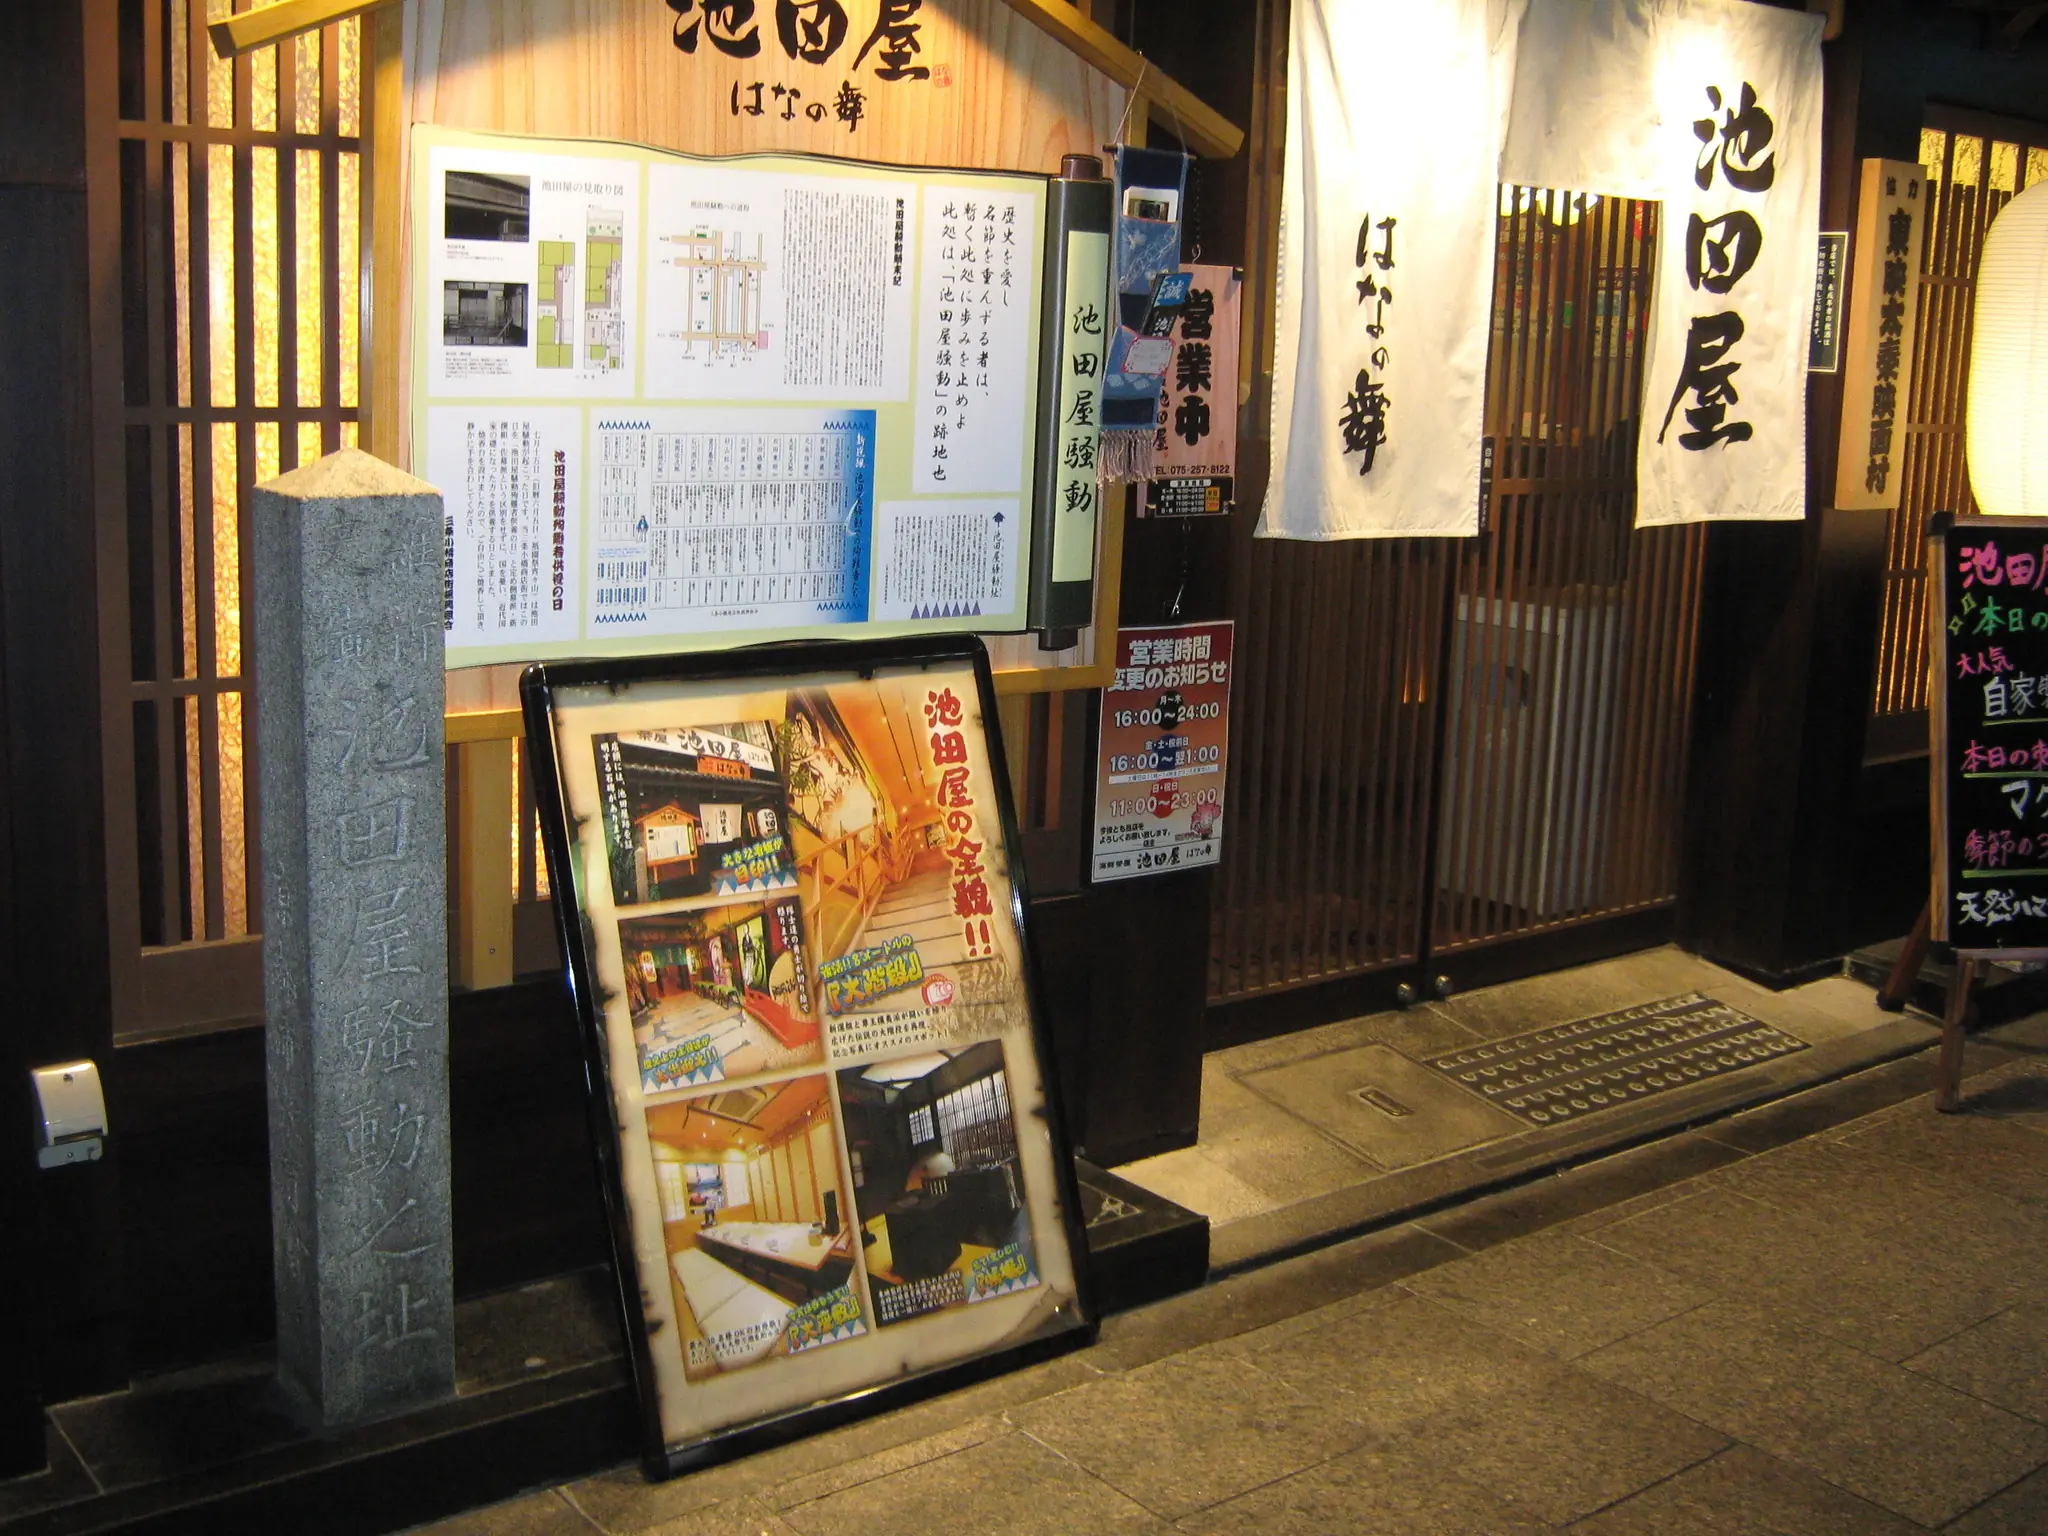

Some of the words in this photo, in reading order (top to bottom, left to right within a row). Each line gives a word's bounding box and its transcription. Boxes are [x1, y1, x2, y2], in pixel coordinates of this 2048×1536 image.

[666, 0, 930, 82] 池田屋
[731, 80, 867, 132] はなの舞
[541, 179, 624, 197] 池田屋の見取り図
[976, 204, 996, 396] 名節を重んずる者は、
[1000, 206, 1016, 307] 歴史を愛し
[1657, 81, 1776, 451] 池田屋
[956, 202, 978, 430] 暫く此処に歩みを止めよ
[1338, 211, 1397, 477] はなの舞
[1063, 303, 1101, 513] 池田屋騒動
[1174, 288, 1215, 447] 営業中
[1129, 634, 1211, 666] 営業時間
[1957, 646, 2015, 679] 大人気
[677, 729, 745, 763] 池田屋
[1137, 846, 1181, 869] 池田屋
[328, 690, 437, 1350] 池田屋騒動之址
